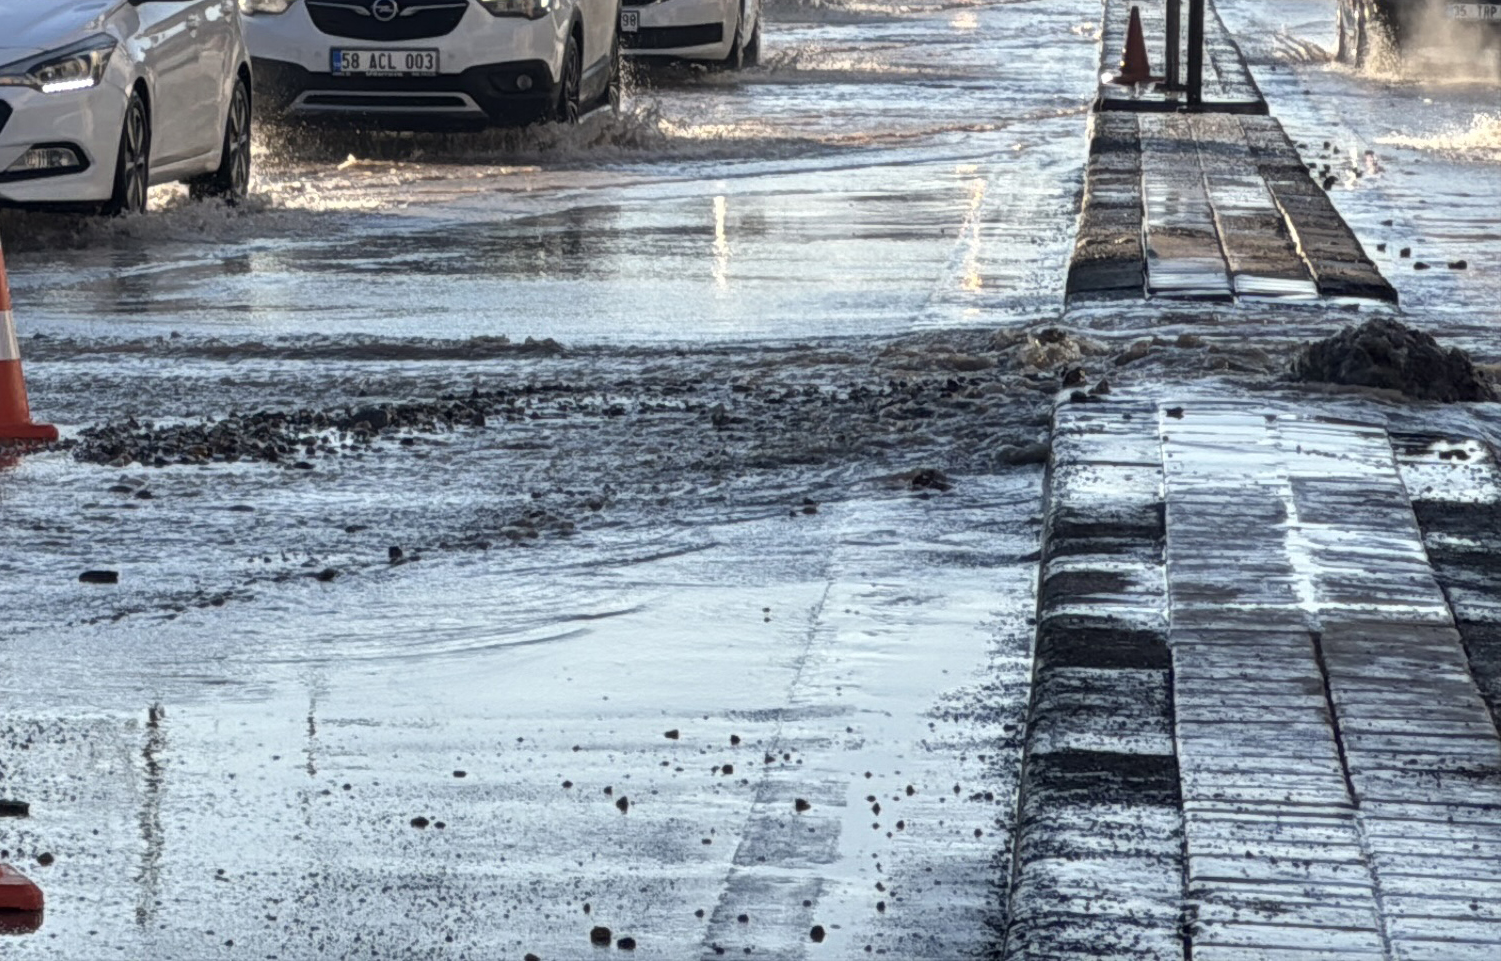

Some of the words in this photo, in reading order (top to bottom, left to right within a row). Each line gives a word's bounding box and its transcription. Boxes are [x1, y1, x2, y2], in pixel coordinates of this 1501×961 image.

[341, 52, 360, 69] 58
[369, 53, 397, 70] ACL
[405, 54, 434, 70] 003
